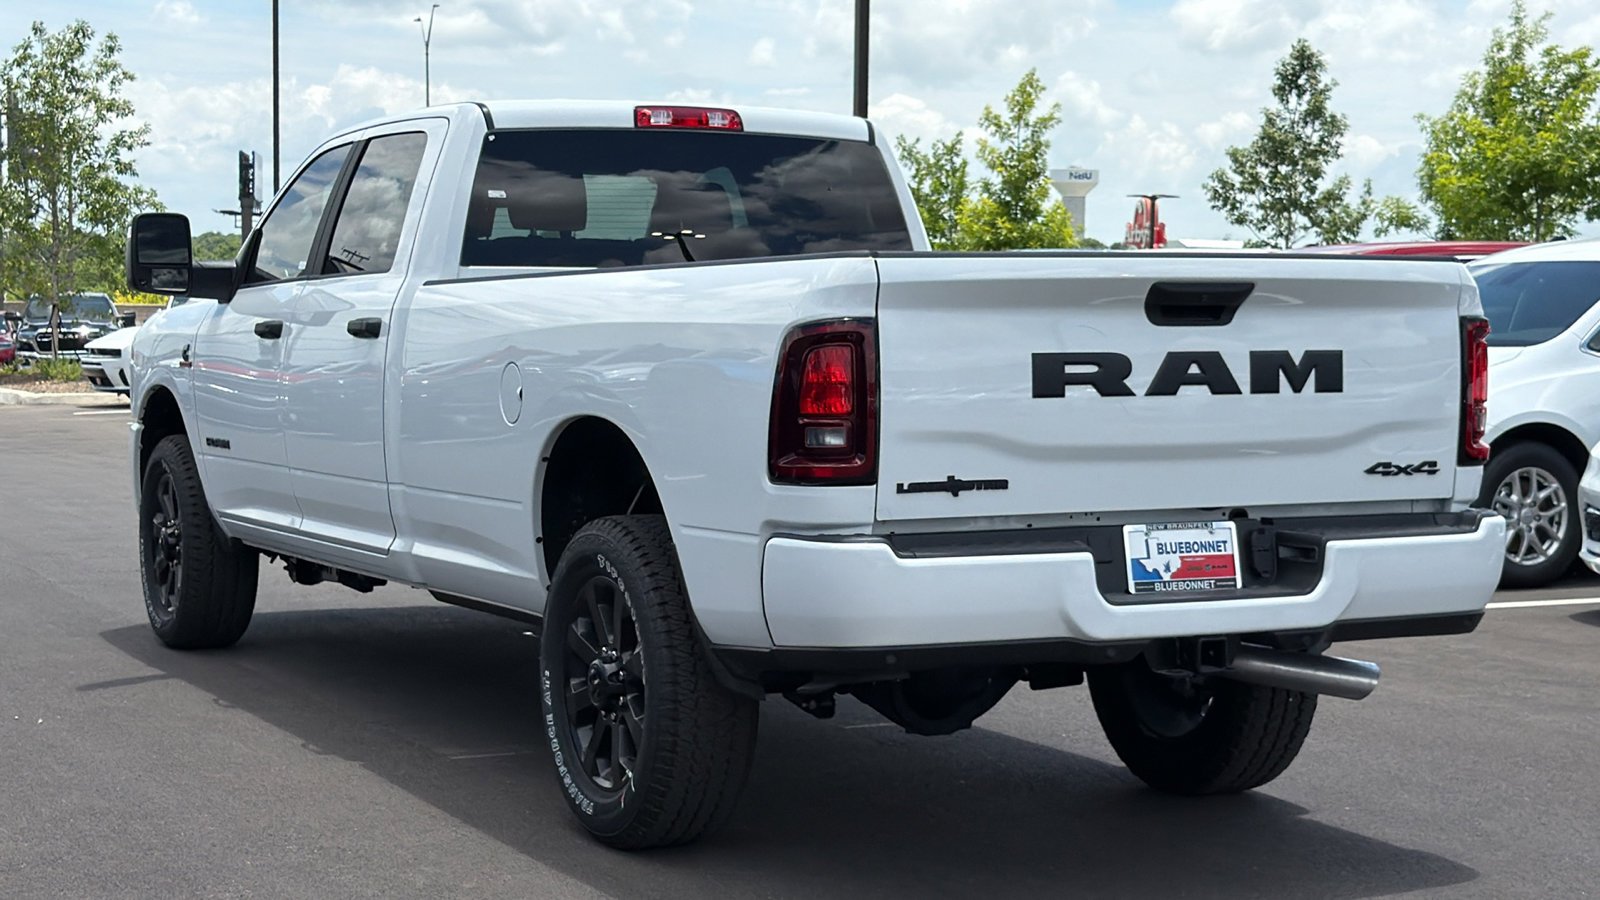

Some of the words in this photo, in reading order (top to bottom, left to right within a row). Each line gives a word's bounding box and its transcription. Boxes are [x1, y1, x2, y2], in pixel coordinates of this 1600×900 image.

[1031, 349, 1343, 398] RAM
[1166, 522, 1213, 530] BRAUNFELS
[1156, 541, 1227, 554] BLUEBONNET
[1155, 580, 1215, 591] BLUEBONNET
